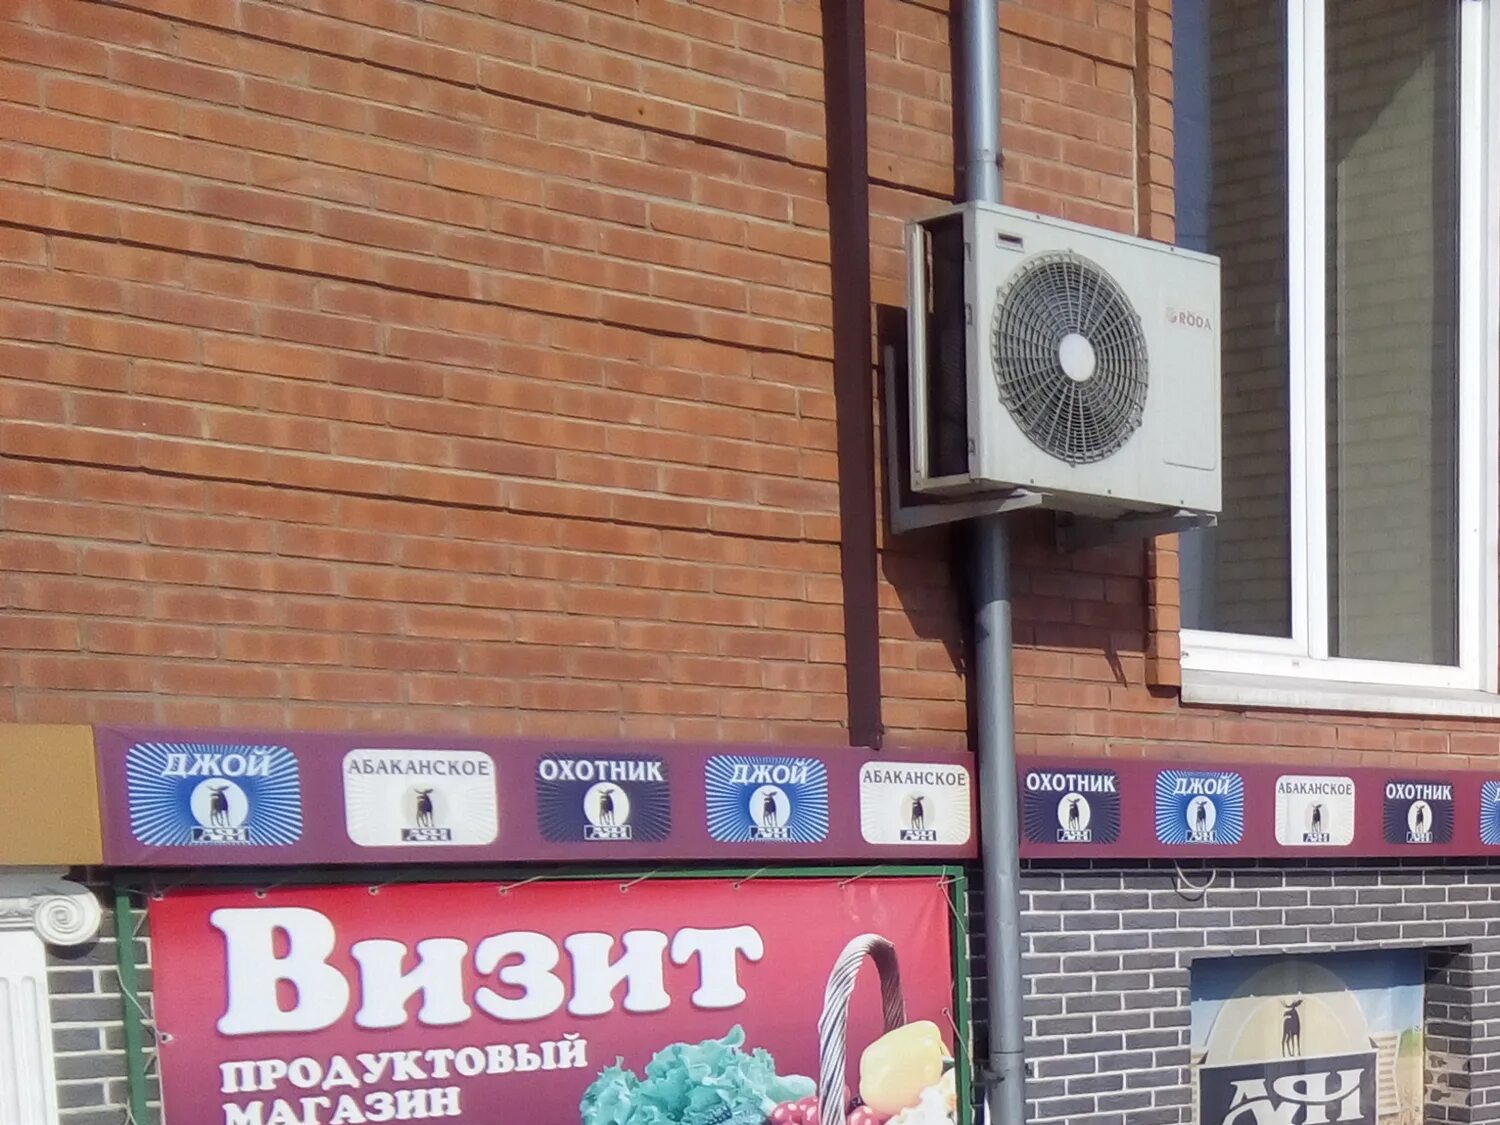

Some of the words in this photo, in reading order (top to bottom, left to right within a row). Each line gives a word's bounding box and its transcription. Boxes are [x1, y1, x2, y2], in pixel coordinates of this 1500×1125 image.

[161, 750, 272, 778] ДЖОЙ
[348, 758, 490, 776] АБАКАНСКОЕ
[538, 759, 664, 781] ОХОТНИК
[730, 759, 808, 785] ДЖОЙ
[863, 769, 966, 786] АБАКАНСКОЕ
[1026, 772, 1117, 792] ОХОТНИК
[1173, 774, 1231, 796] ДЖОЙ
[1278, 782, 1352, 796] АБАКАНСКОЕ
[1385, 783, 1453, 801] ОХОТНИК
[209, 906, 764, 1036] Визит
[219, 1032, 589, 1094] ПРОДУКТОВЫЙ
